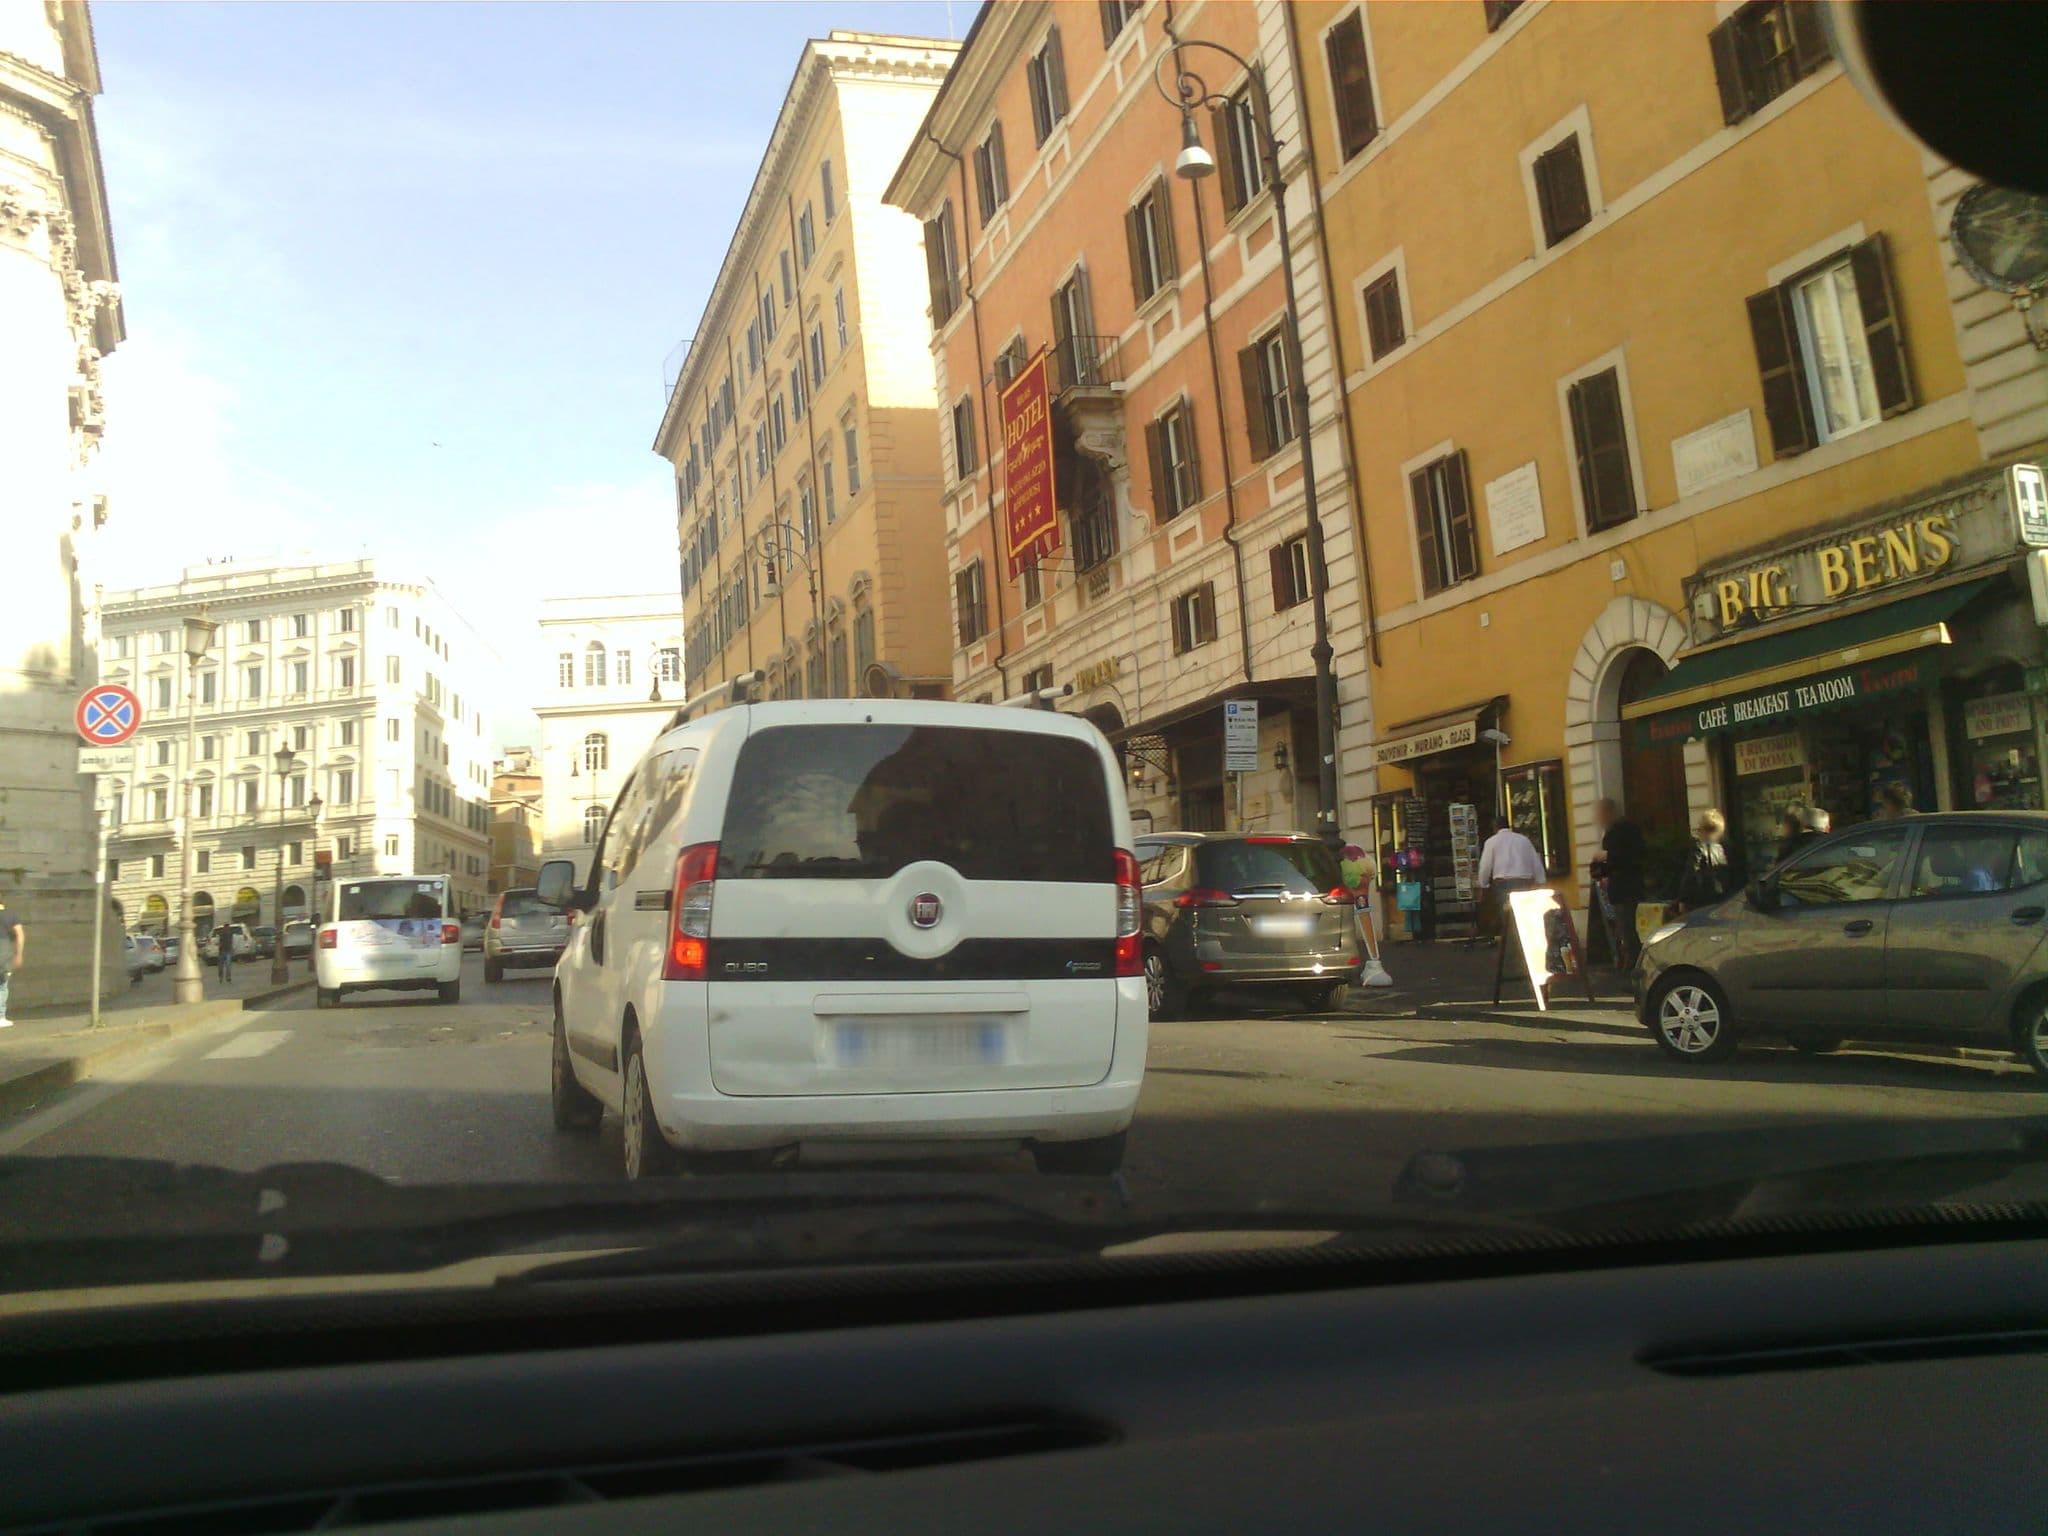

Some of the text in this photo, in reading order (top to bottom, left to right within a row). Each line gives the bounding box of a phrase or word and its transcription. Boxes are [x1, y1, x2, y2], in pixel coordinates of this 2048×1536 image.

[1007, 395, 1045, 449] HOTEL
[1717, 566, 1791, 627] BIG
[1818, 515, 1952, 597] BENS
[1698, 702, 1728, 730] CAFFÈ
[1733, 691, 1790, 723] BREAKFAST
[1796, 685, 1819, 708] TEA
[1819, 676, 1856, 703] ROOM
[1377, 728, 1471, 762] SOUVENIR MURANO GLASS
